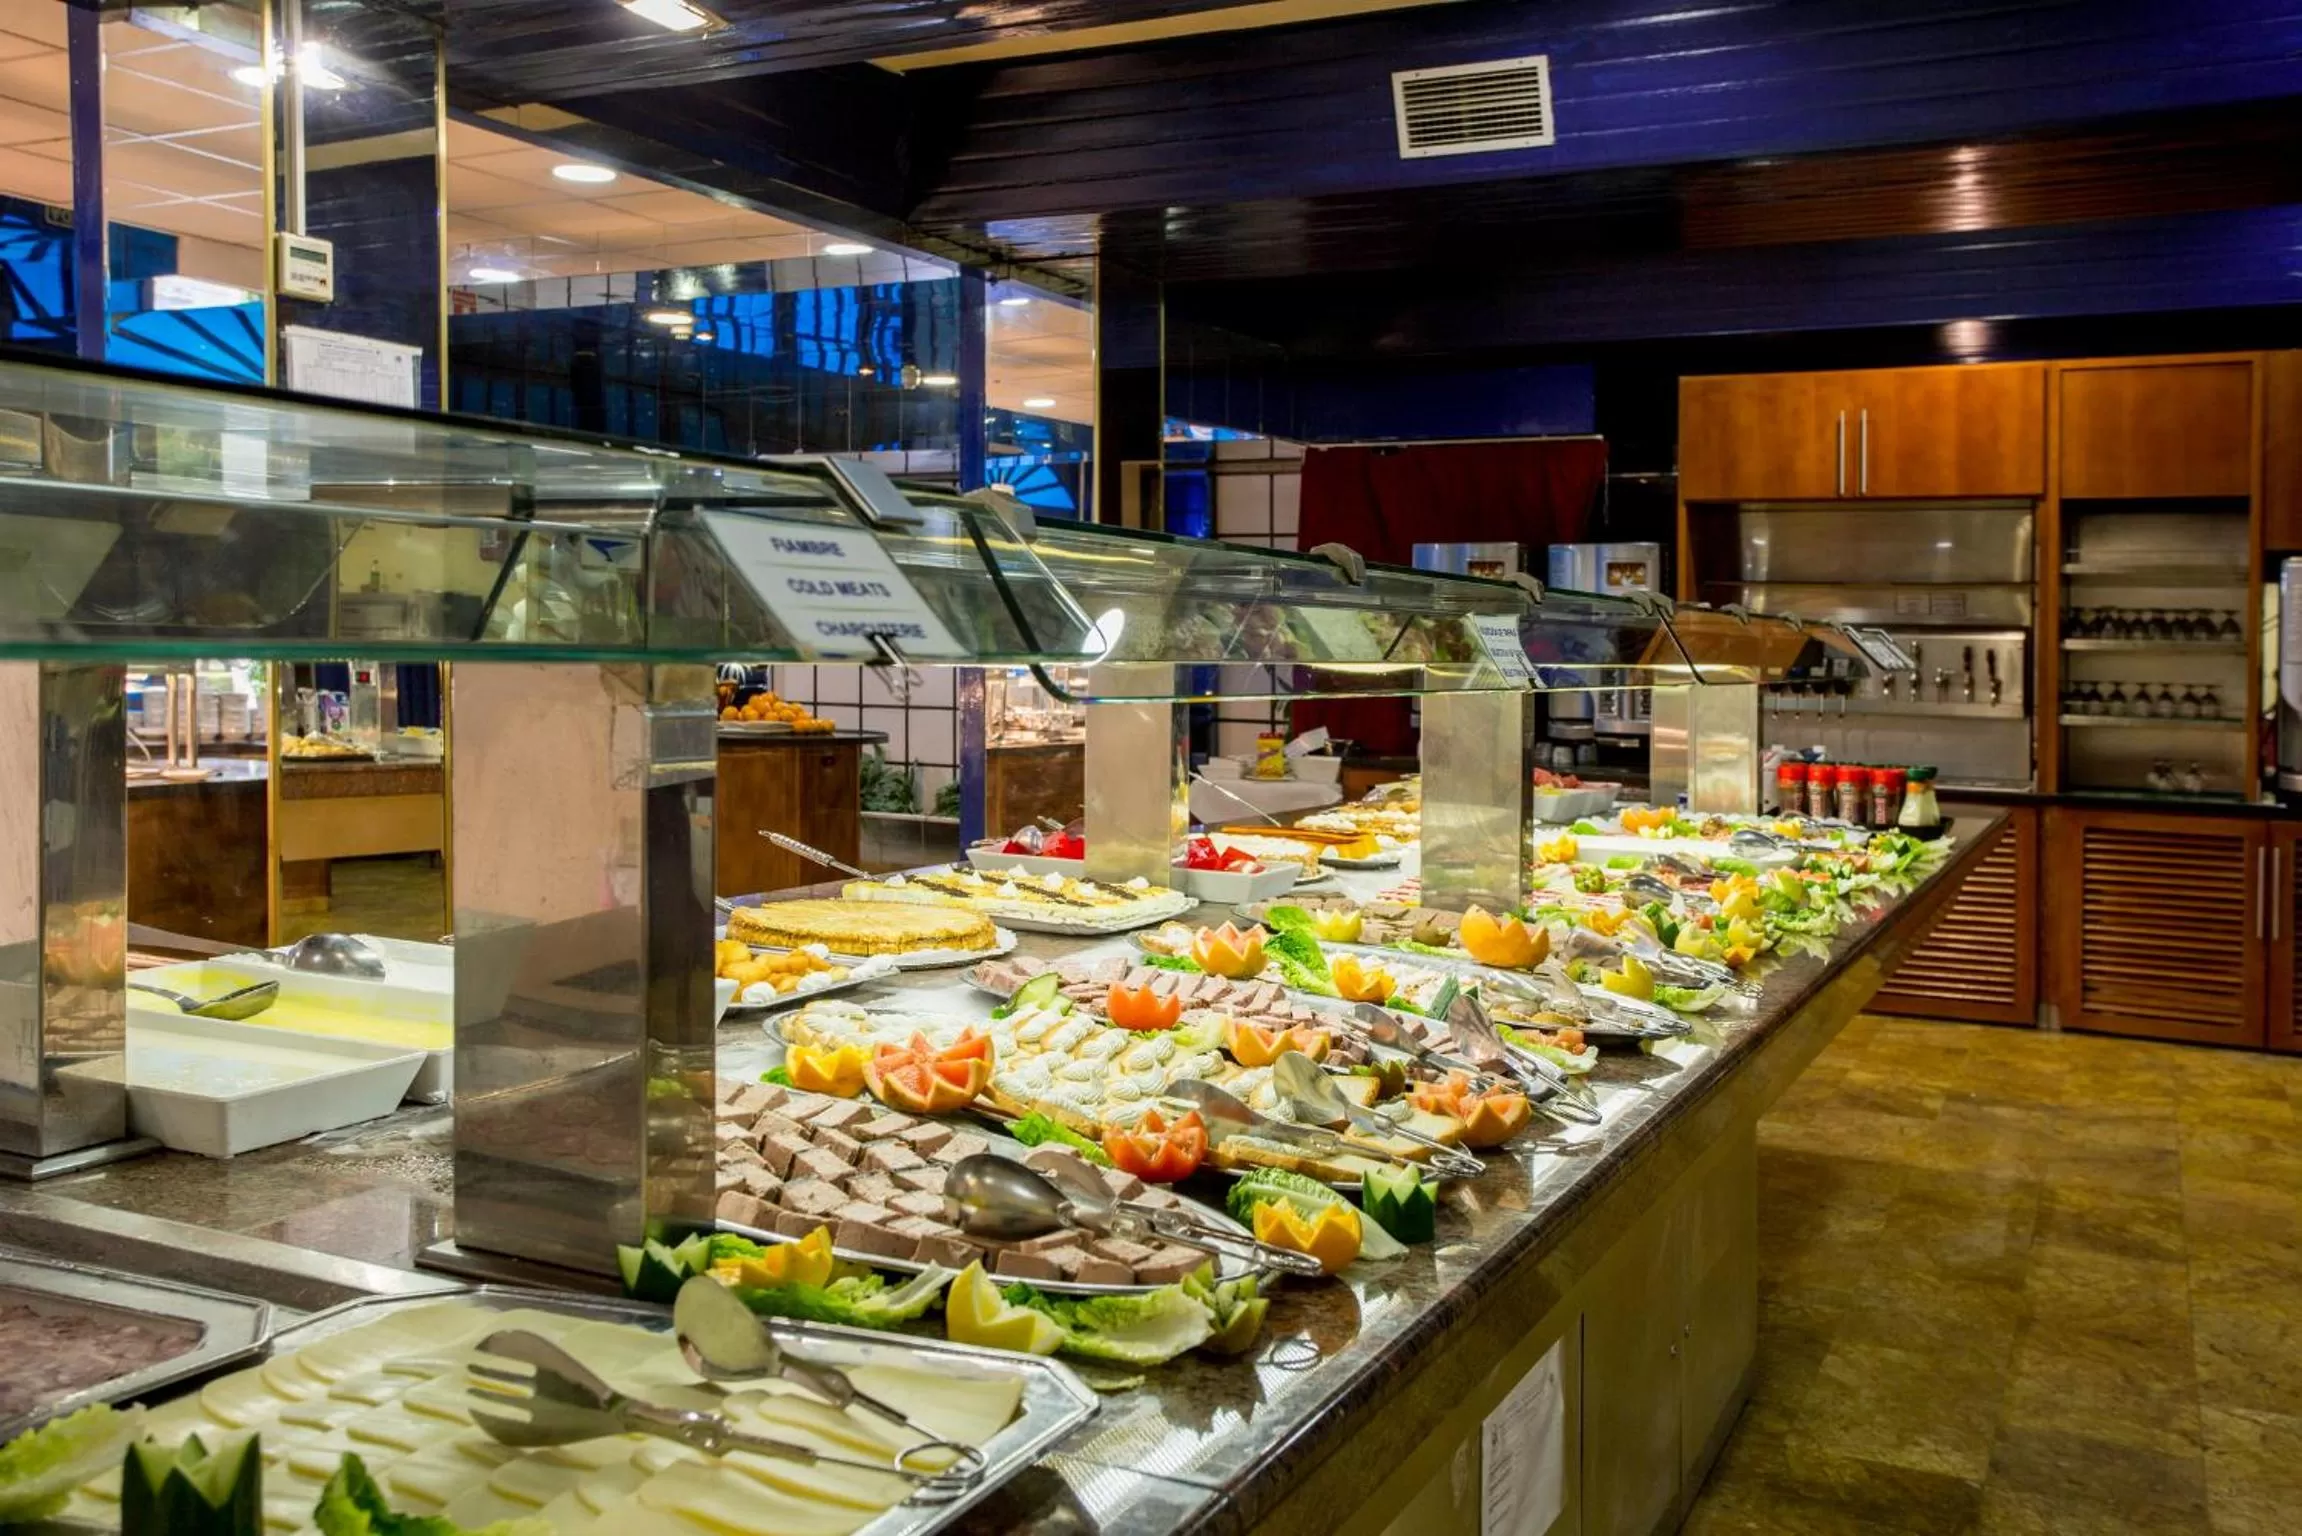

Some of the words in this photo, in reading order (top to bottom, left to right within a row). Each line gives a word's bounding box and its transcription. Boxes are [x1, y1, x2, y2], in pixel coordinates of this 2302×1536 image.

[769, 536, 846, 557] FIAMBRE
[787, 577, 835, 596] COLD
[836, 581, 892, 598] MEATS
[815, 620, 927, 639] CHARCUTERIE
